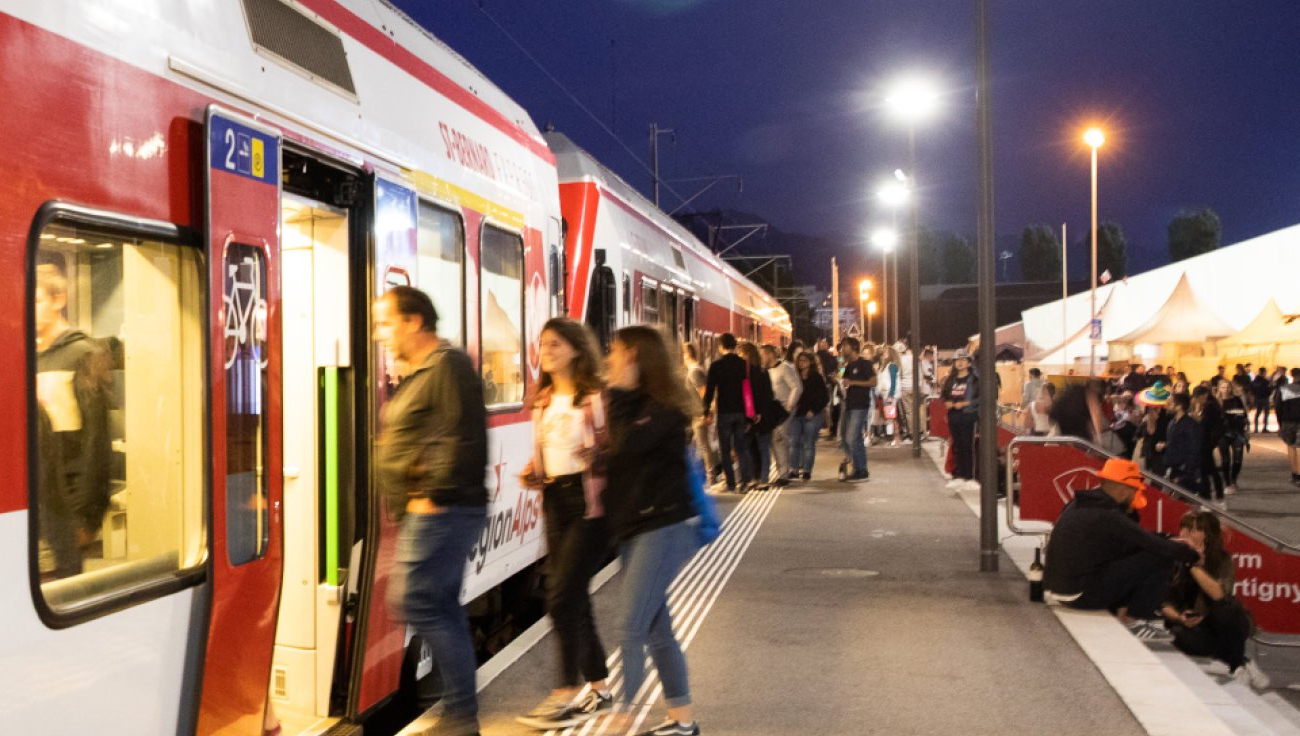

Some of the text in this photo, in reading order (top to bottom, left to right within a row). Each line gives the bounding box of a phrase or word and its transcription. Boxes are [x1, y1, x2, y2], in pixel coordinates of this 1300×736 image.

[225, 127, 236, 170] 2
[468, 488, 542, 575] egionAlps
[1231, 552, 1262, 569] rm
[1232, 576, 1300, 603] rtigny
